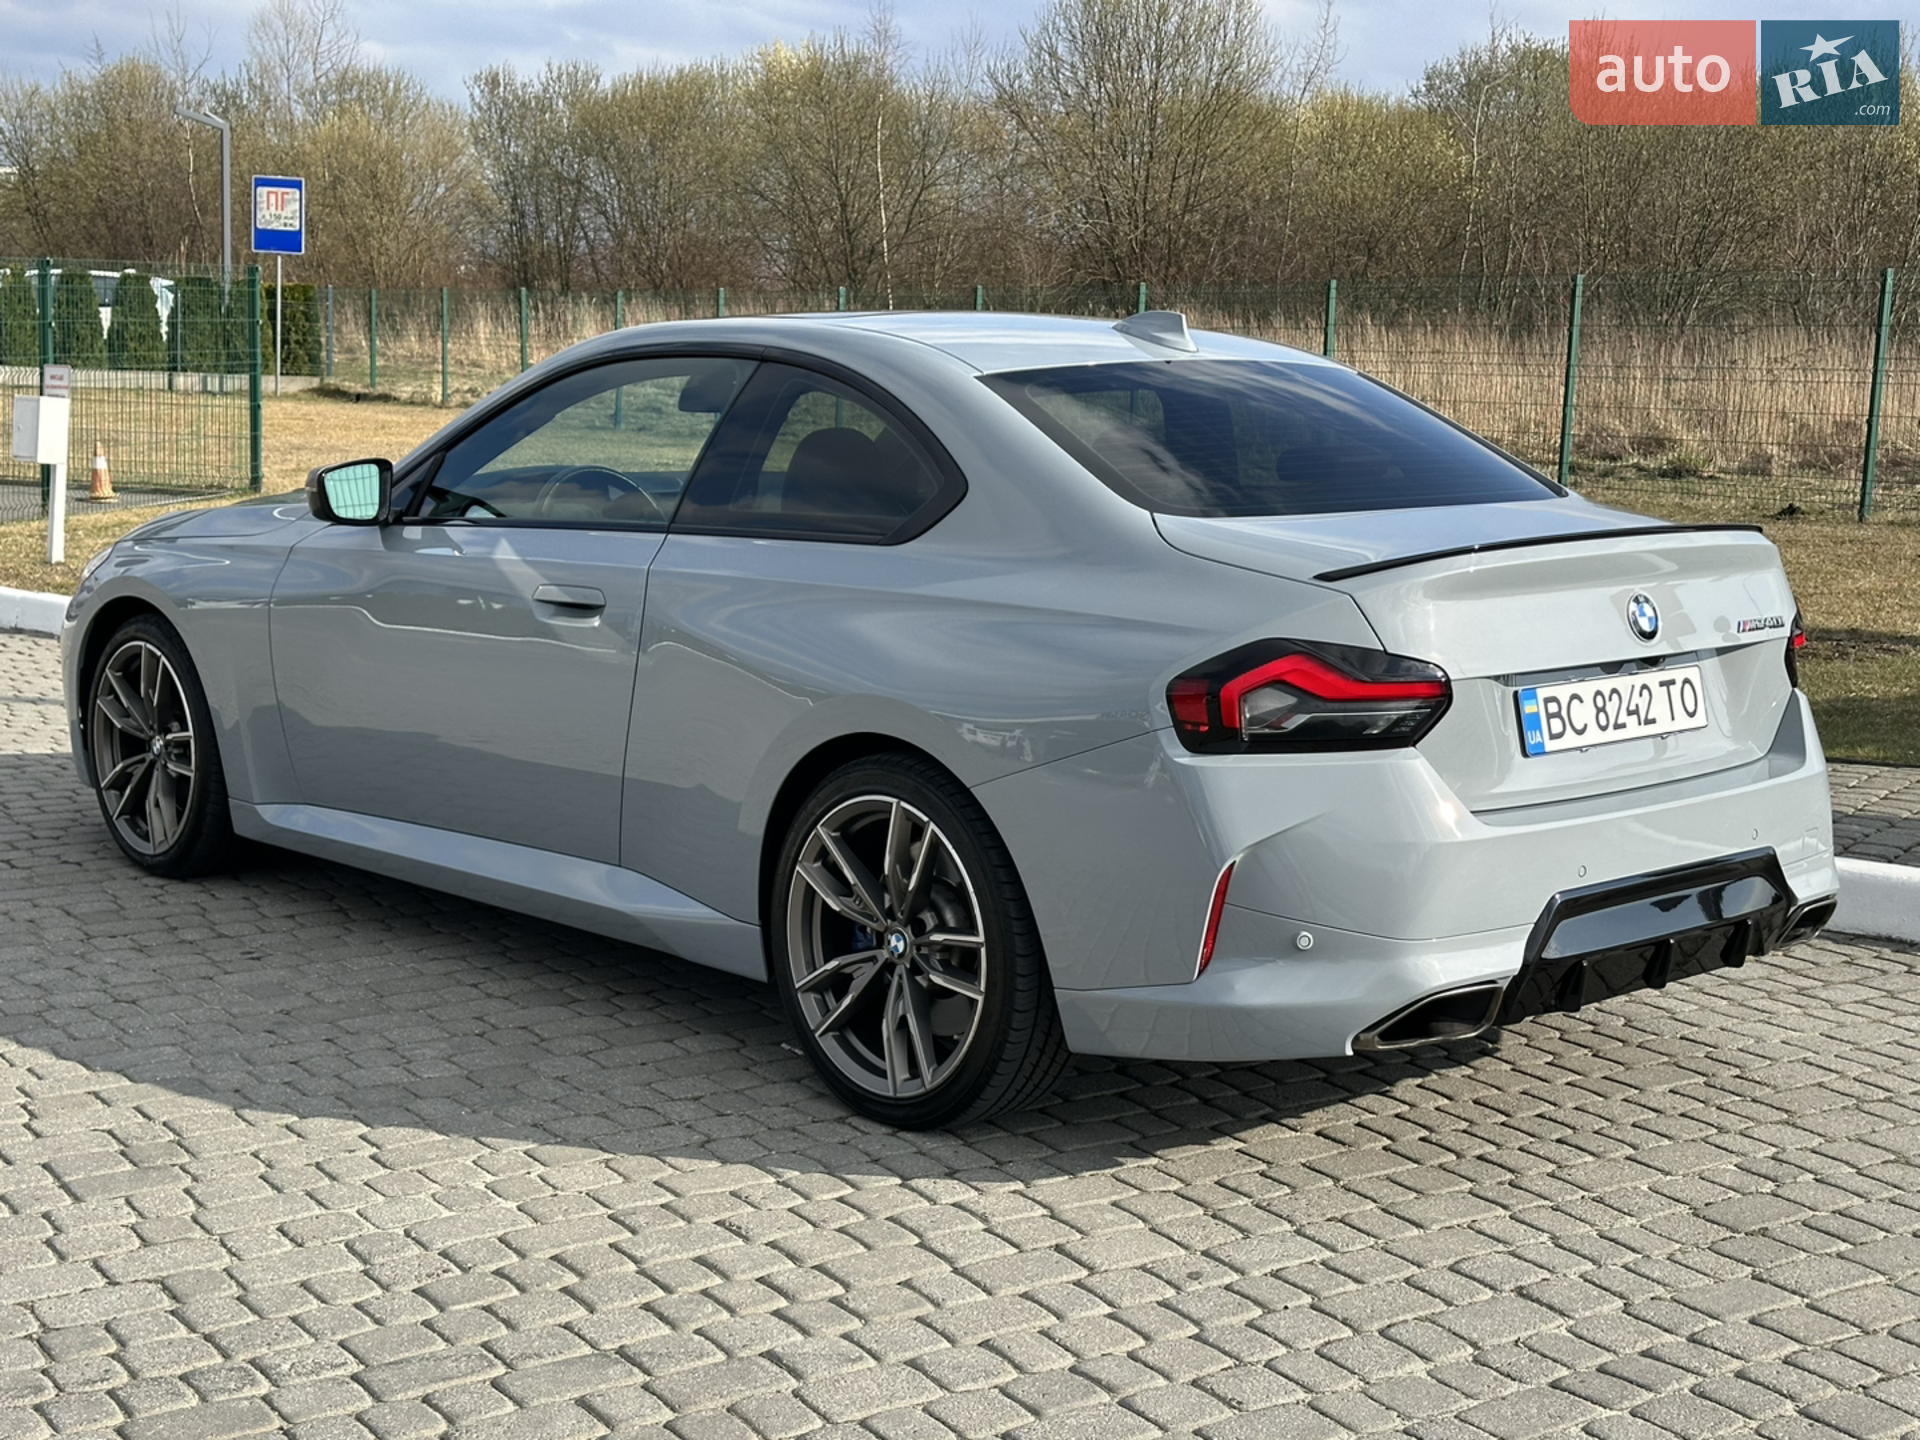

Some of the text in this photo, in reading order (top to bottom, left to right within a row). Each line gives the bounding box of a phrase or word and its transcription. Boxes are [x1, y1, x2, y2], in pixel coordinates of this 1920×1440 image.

[266, 191, 290, 211] ПГ
[1543, 676, 1698, 740] BC 8242 TO
[1527, 730, 1543, 745] UA
